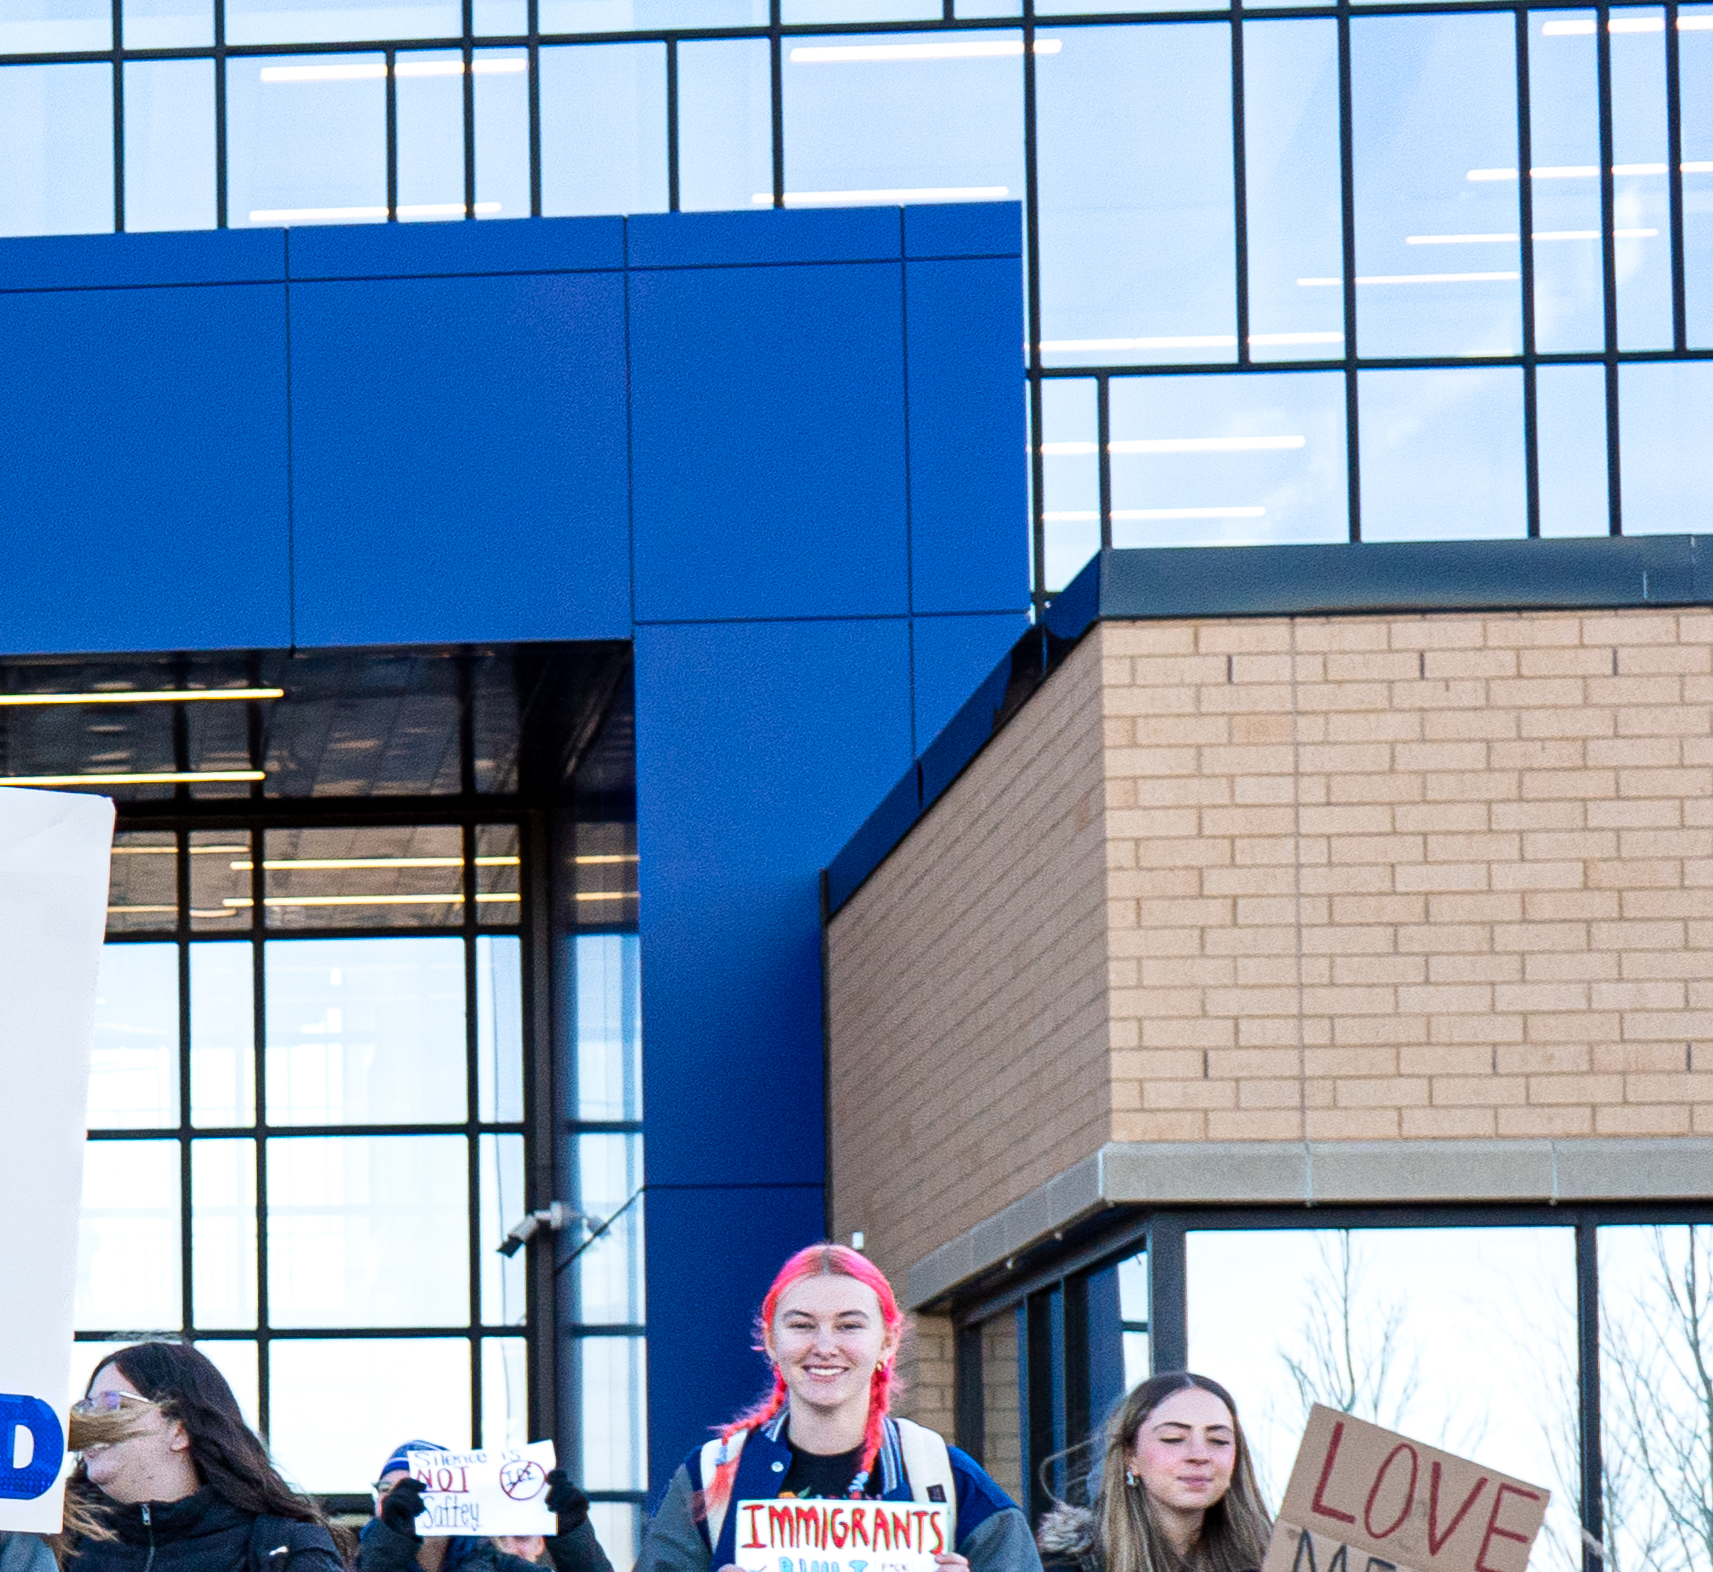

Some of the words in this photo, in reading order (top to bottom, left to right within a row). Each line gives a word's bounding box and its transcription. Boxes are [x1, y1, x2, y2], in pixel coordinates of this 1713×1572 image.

[414, 1452, 488, 1467] Silence
[417, 1465, 469, 1492] NOT
[741, 1503, 944, 1555] IMMIGRANTS
